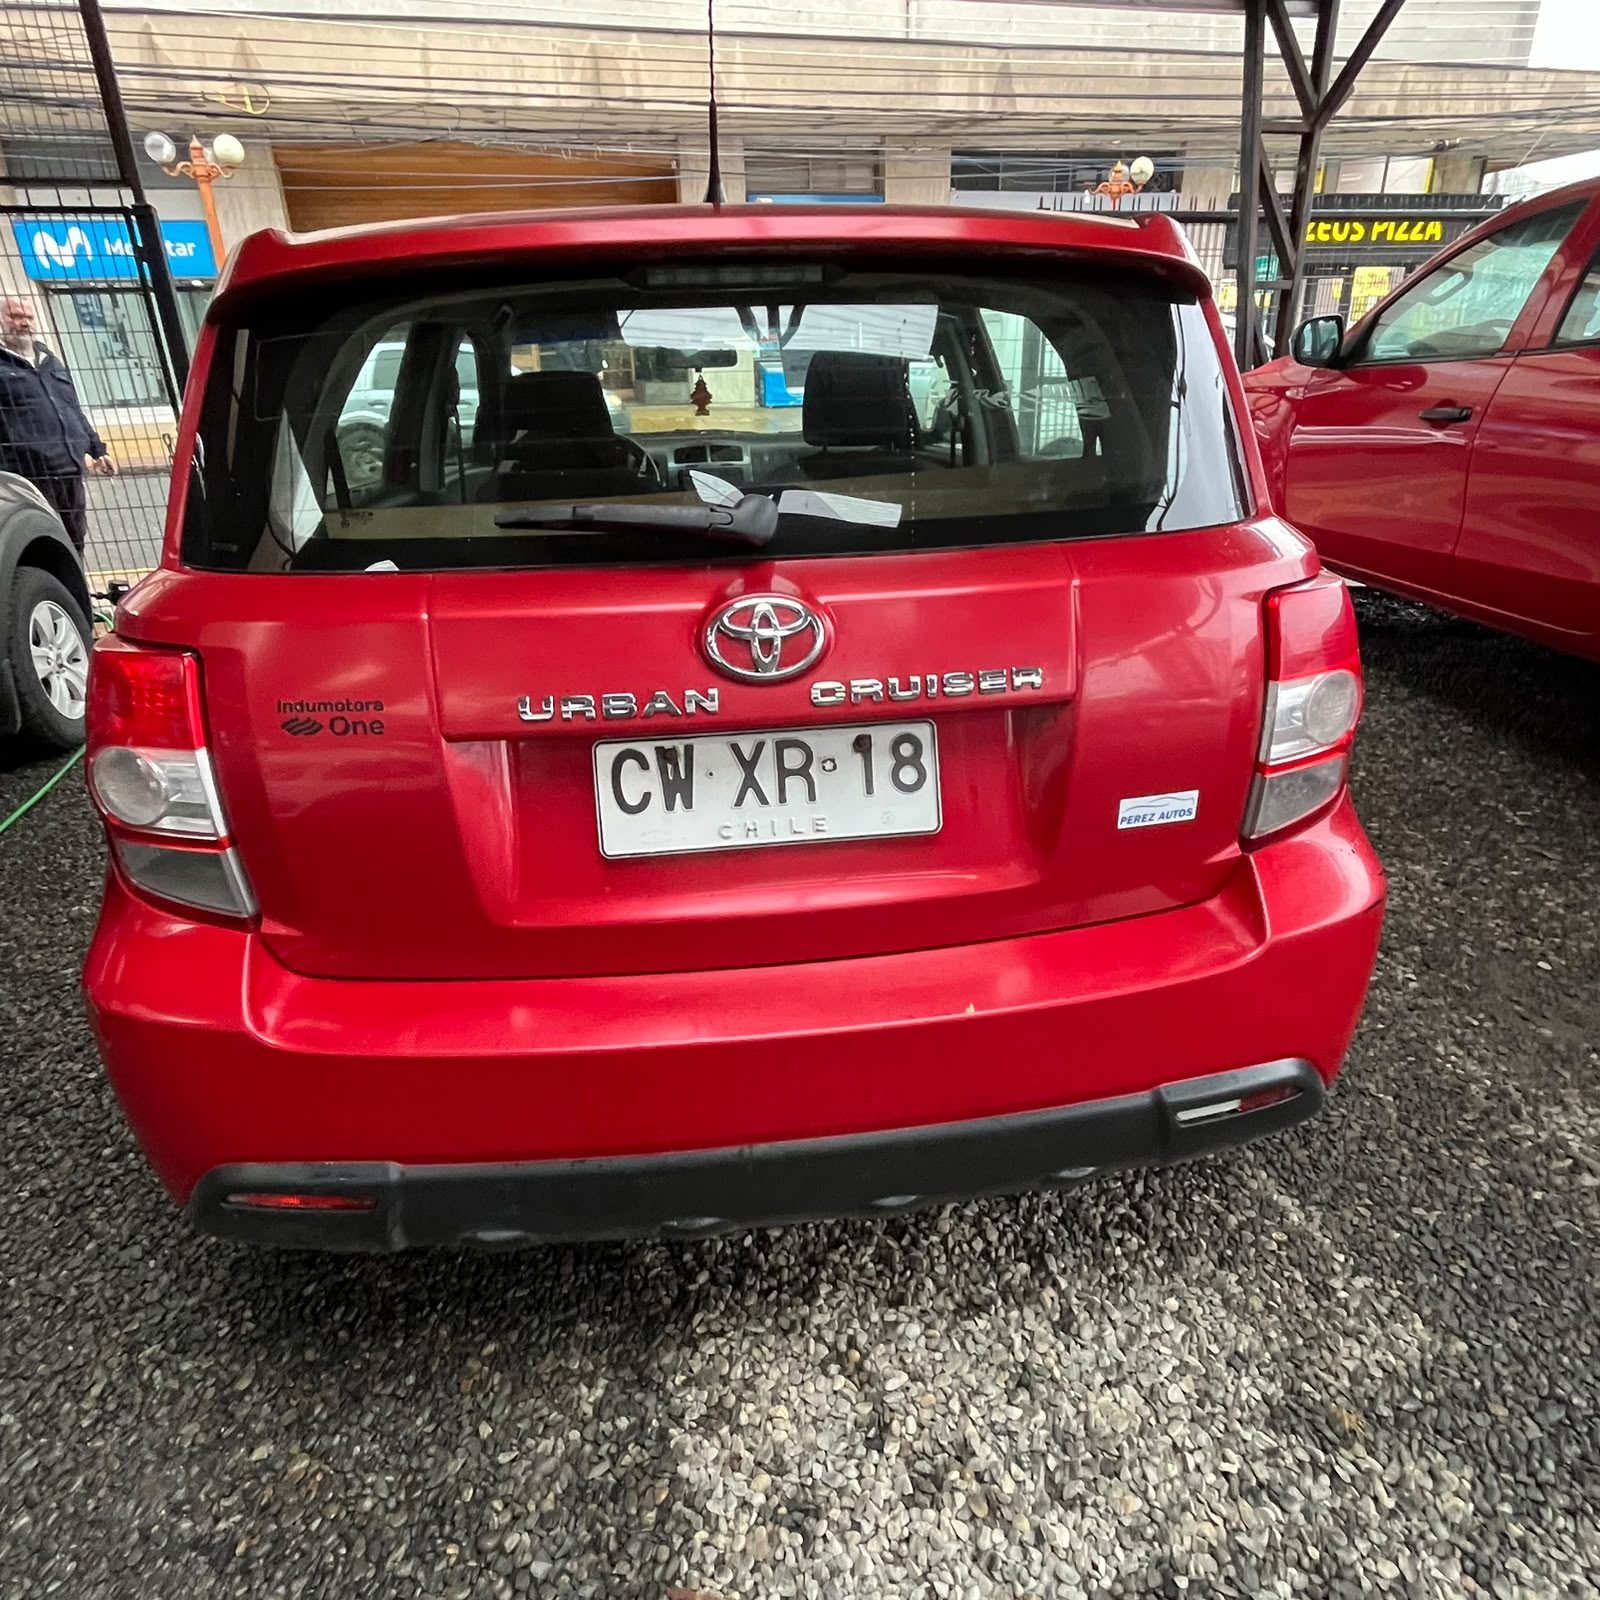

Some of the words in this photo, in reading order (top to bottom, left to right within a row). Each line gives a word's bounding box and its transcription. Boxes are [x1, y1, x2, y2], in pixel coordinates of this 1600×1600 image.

[1371, 221, 1442, 241] PIZZA
[518, 687, 720, 722] URBAN
[810, 666, 1043, 707] CRUISER
[277, 698, 385, 713] Indumotora
[329, 716, 385, 736] One
[1120, 812, 1156, 825] PEREZ
[1158, 807, 1194, 820] AUTOS
[717, 816, 828, 840] CHILE
